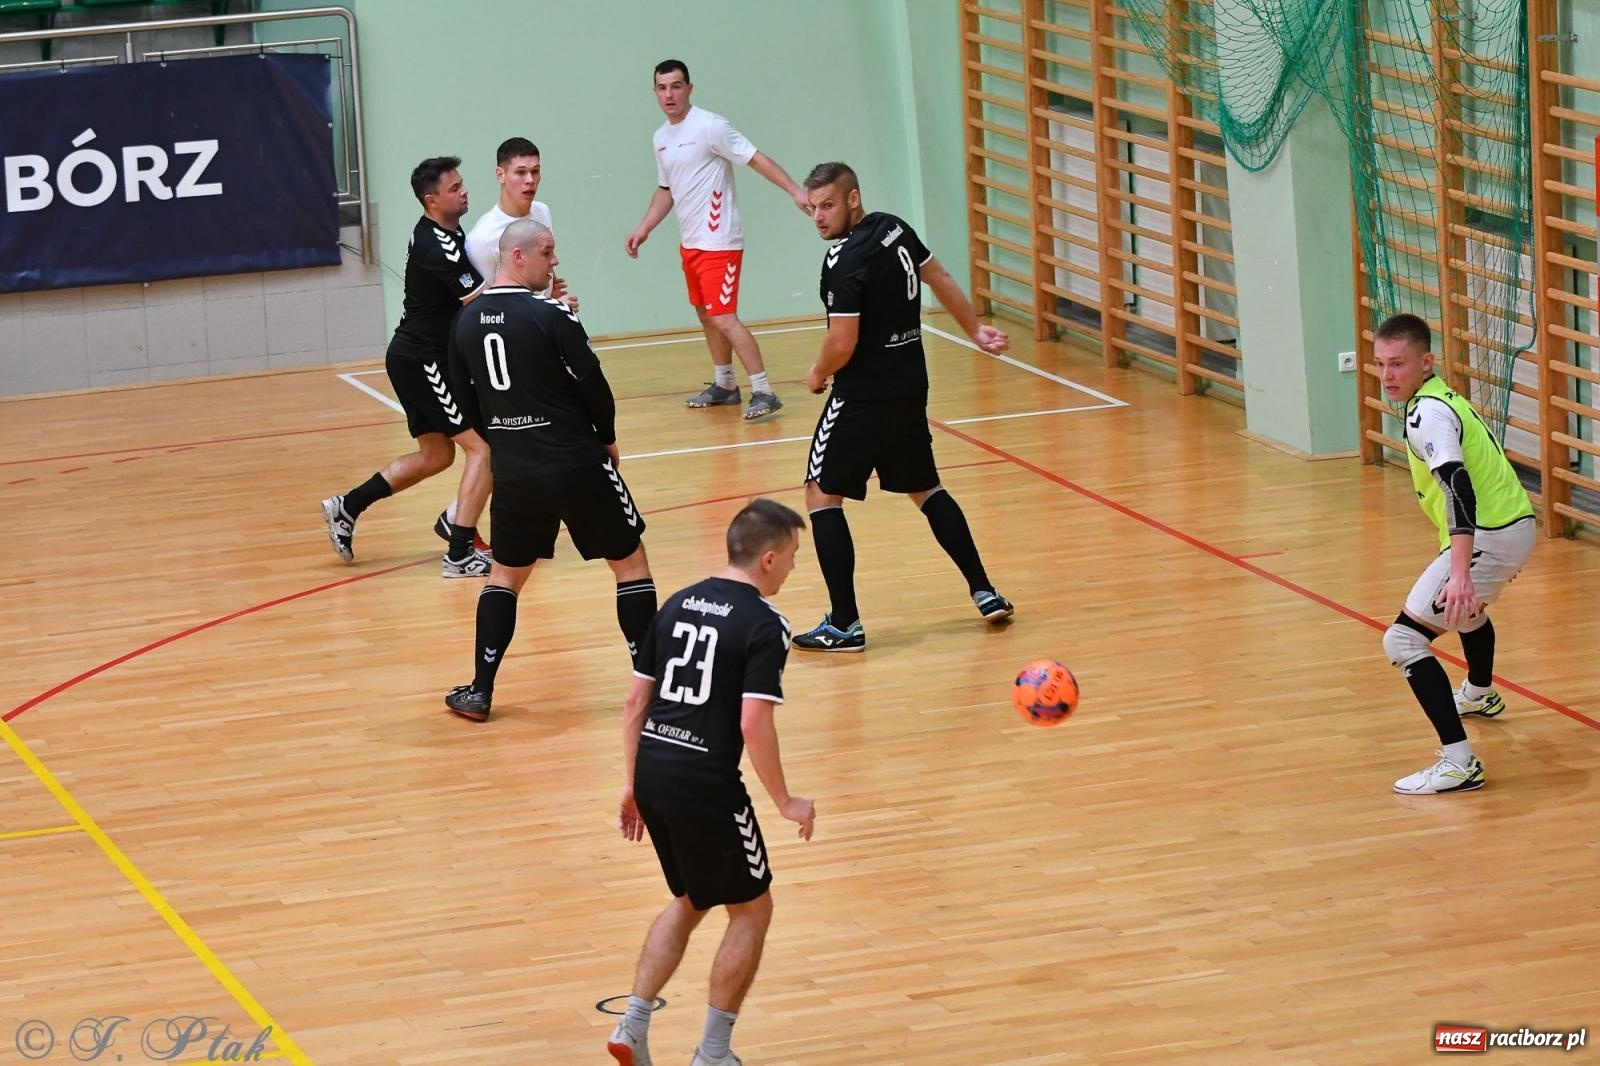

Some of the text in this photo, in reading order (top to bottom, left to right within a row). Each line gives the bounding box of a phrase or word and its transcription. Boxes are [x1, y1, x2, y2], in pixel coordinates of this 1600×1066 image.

[4, 127, 223, 213] BÓRZ
[897, 245, 918, 301] 8
[480, 312, 505, 324] kocot
[483, 332, 511, 391] 0
[660, 621, 718, 706] 23
[657, 723, 691, 741] OFISTAR
